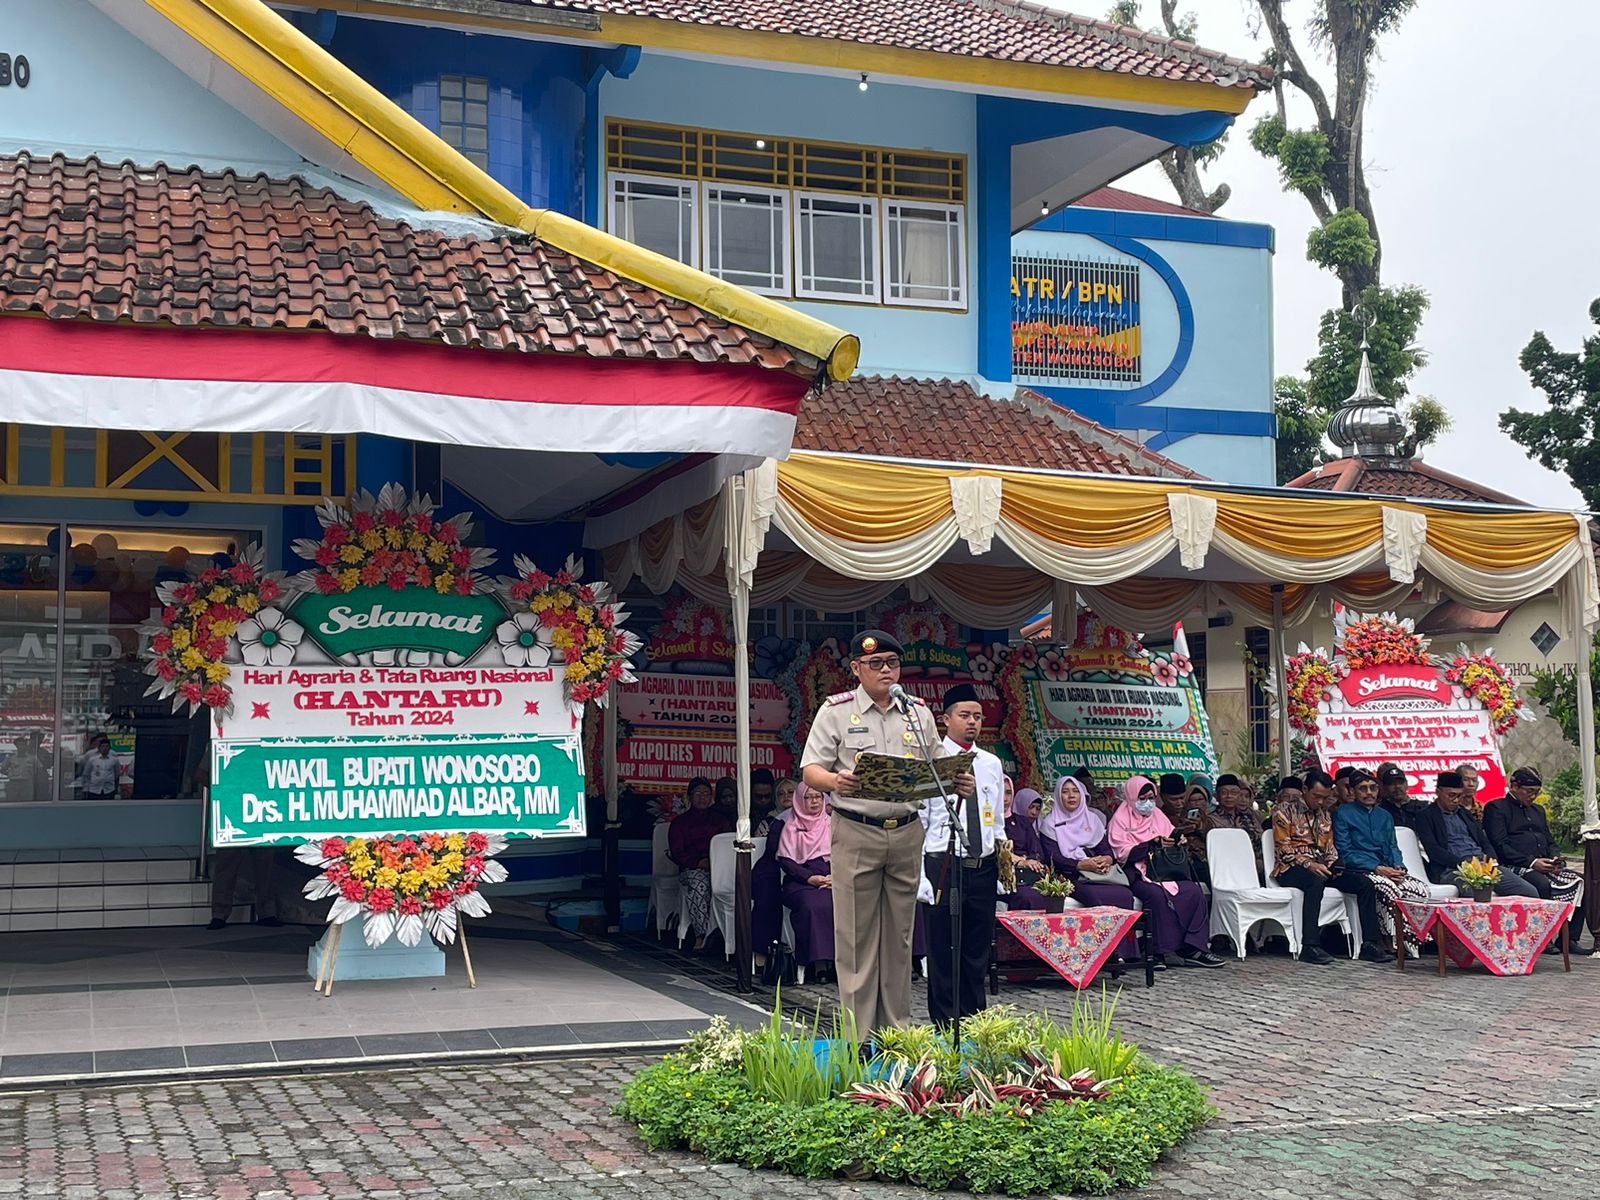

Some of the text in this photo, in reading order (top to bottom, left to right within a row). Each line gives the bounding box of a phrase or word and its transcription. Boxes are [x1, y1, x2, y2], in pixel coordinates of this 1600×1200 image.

[1011, 276, 1054, 299] ATR
[1079, 281, 1122, 304] BPN
[1048, 353, 1134, 368] WONOSOBO
[319, 604, 483, 635] Selamat
[929, 648, 961, 667] Sukses
[243, 668, 554, 688] Hari Agraria & Tata Ruang Nasional
[1358, 674, 1438, 696] Selamat
[641, 677, 676, 695] AGRARIA
[678, 679, 694, 696] DAN
[697, 680, 715, 697] TATA
[293, 688, 502, 710] (HANTARU)
[661, 698, 736, 711] (HANTARU
[1049, 687, 1182, 707] HARI AGRARIA DAN TATA RUANG NASIONAL
[346, 711, 454, 726] Tahun 2024
[652, 712, 704, 722] TAHUN
[1088, 706, 1154, 718] (HANTARU)
[1083, 717, 1163, 728] TAHUN 2024
[1326, 715, 1479, 728] Hari Agraria & Tata Ruang Nasional
[1353, 727, 1457, 740] (HANTARU)
[629, 741, 774, 765] KAPOLRES WONOOBO
[1064, 740, 1191, 754] ERAWATI, S.H., M.H.
[1382, 739, 1435, 750] Tahun 2024
[264, 753, 541, 789] WAKIL BUPATI WONOSOBO
[1055, 754, 1206, 771] KEPALA KEJAKSAAN NEGERI WONOSOBO
[1440, 760, 1449, 771] &
[242, 785, 560, 823] Drs. H. MUHAMMAD ALBAR, MM
